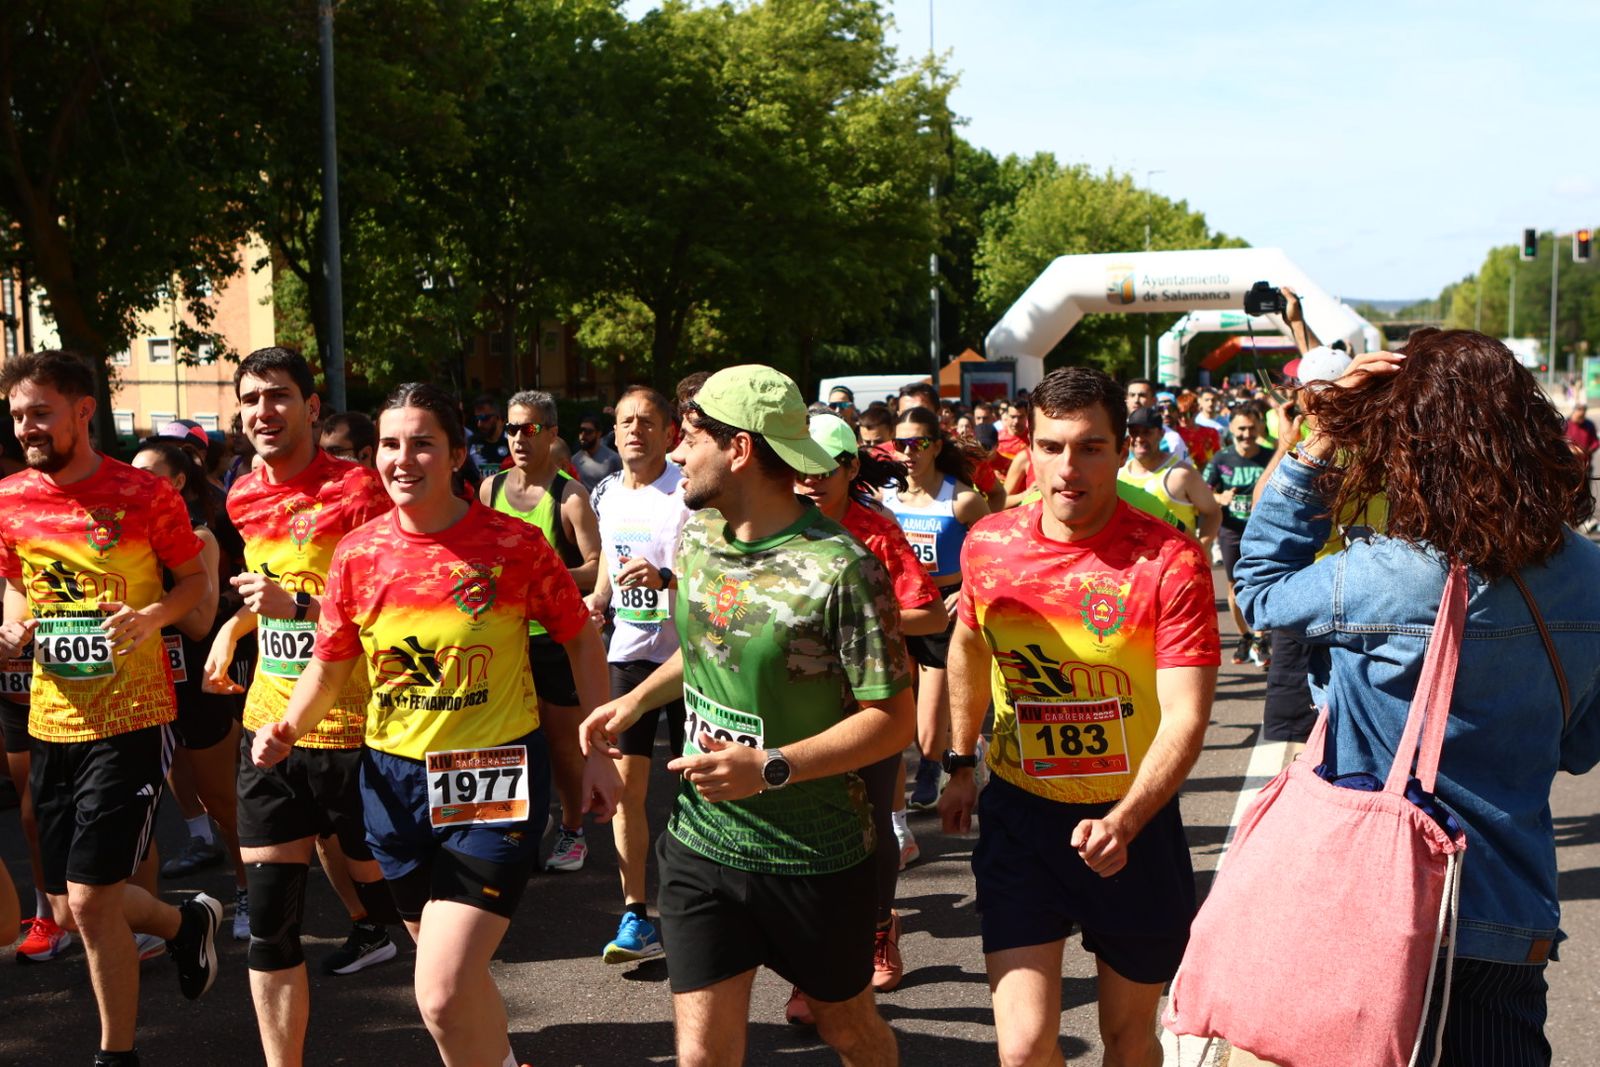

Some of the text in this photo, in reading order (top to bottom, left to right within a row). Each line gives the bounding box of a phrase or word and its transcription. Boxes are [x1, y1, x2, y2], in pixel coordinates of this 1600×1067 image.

[1142, 273, 1230, 288] Ayuntamiento
[1143, 289, 1232, 302] de Salamanca
[903, 517, 943, 533] ARMUÑA
[911, 543, 934, 562] 95
[621, 587, 658, 608] 889
[37, 621, 54, 634] XIV
[38, 635, 109, 663] 1605
[262, 629, 315, 660] 1602
[715, 707, 759, 727] FERNANDO
[1020, 704, 1041, 721] XIV
[1044, 712, 1092, 721] CARRERA
[1035, 723, 1109, 756] 183
[429, 753, 453, 770] XIV
[455, 757, 500, 768] CARRERA
[434, 768, 523, 804] 1977
